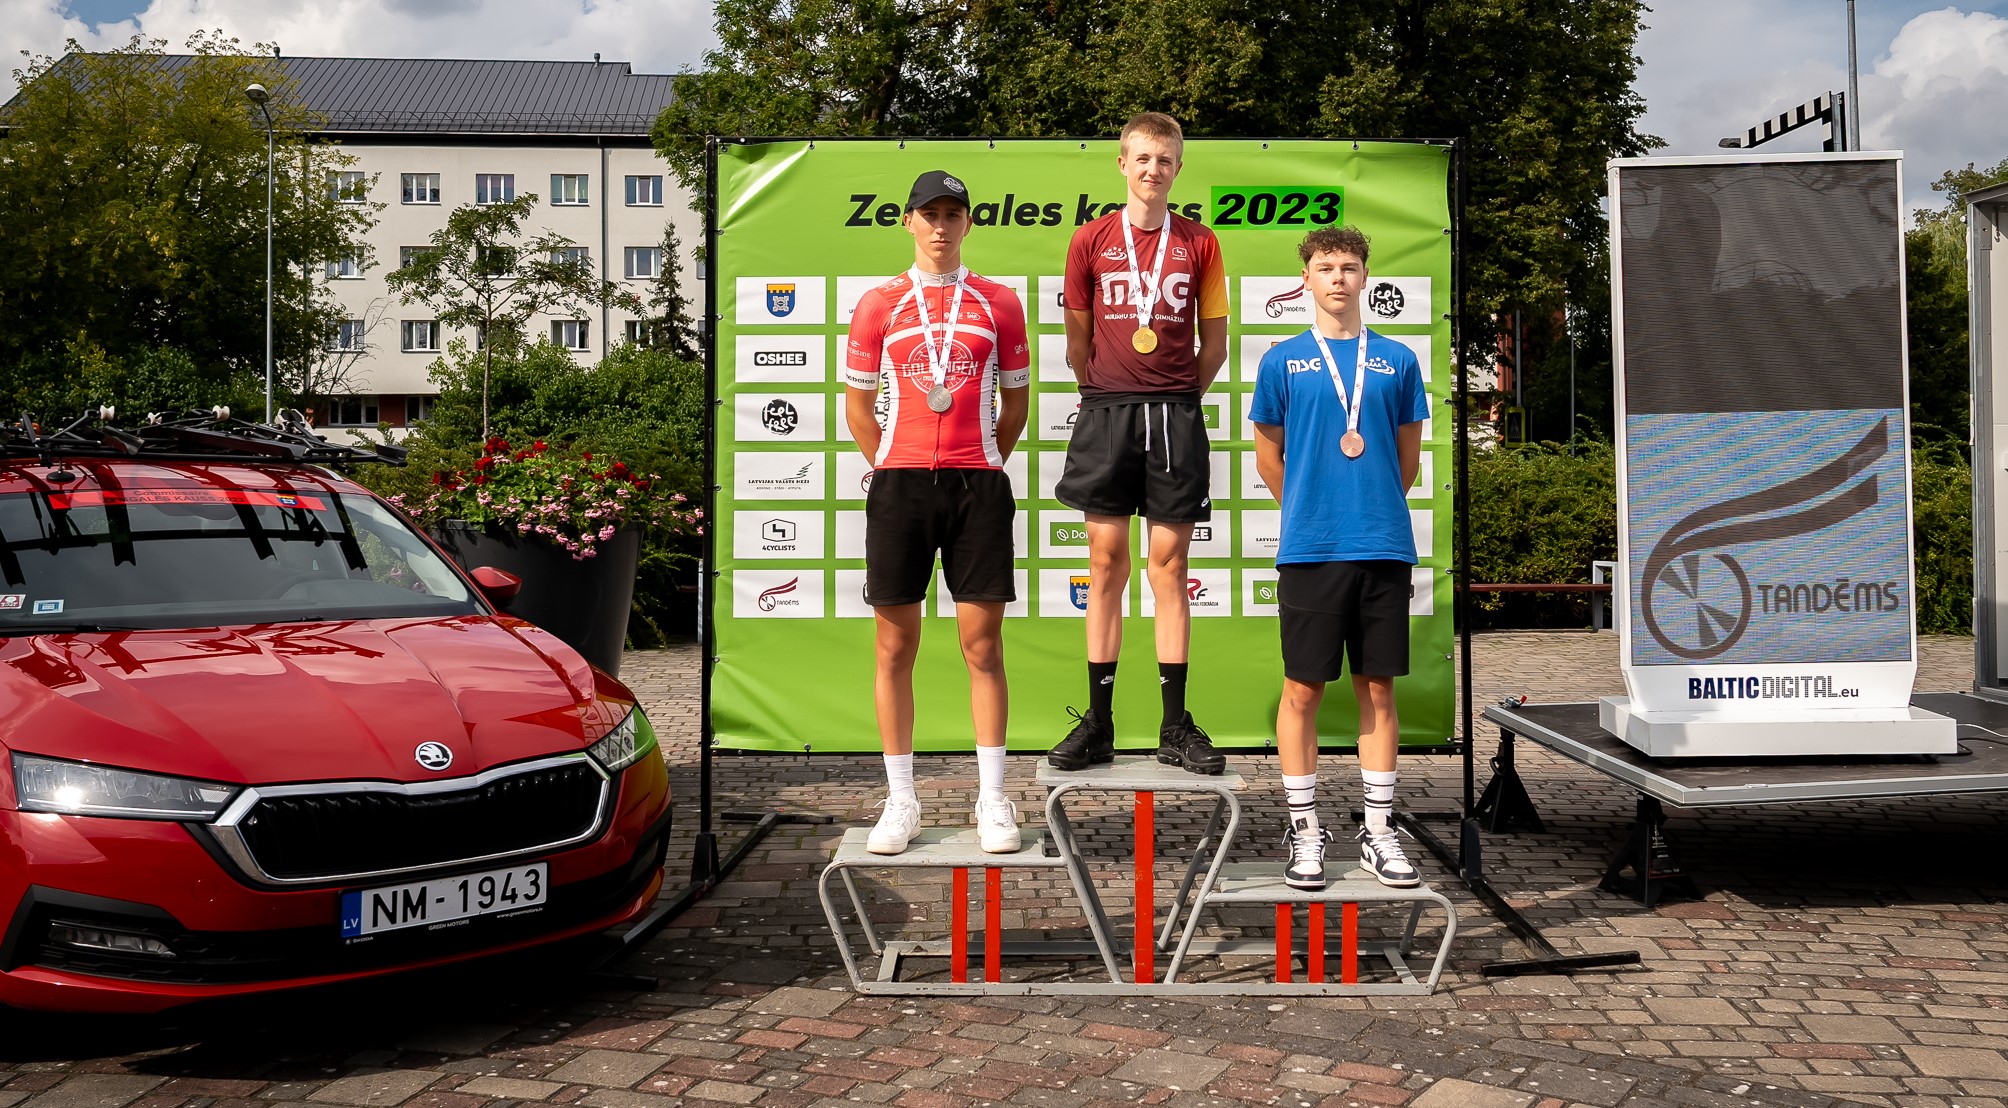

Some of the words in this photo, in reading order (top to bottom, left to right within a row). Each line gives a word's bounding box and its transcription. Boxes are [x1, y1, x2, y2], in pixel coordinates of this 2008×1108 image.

[845, 194, 1064, 227] Zeales
[1213, 192, 1341, 225] 2023
[756, 353, 804, 364] OSHEE
[1757, 578, 1899, 613] TANDĒMS
[343, 918, 358, 930] LV
[428, 923, 446, 931] GREEN
[447, 919, 470, 928] MOTORS
